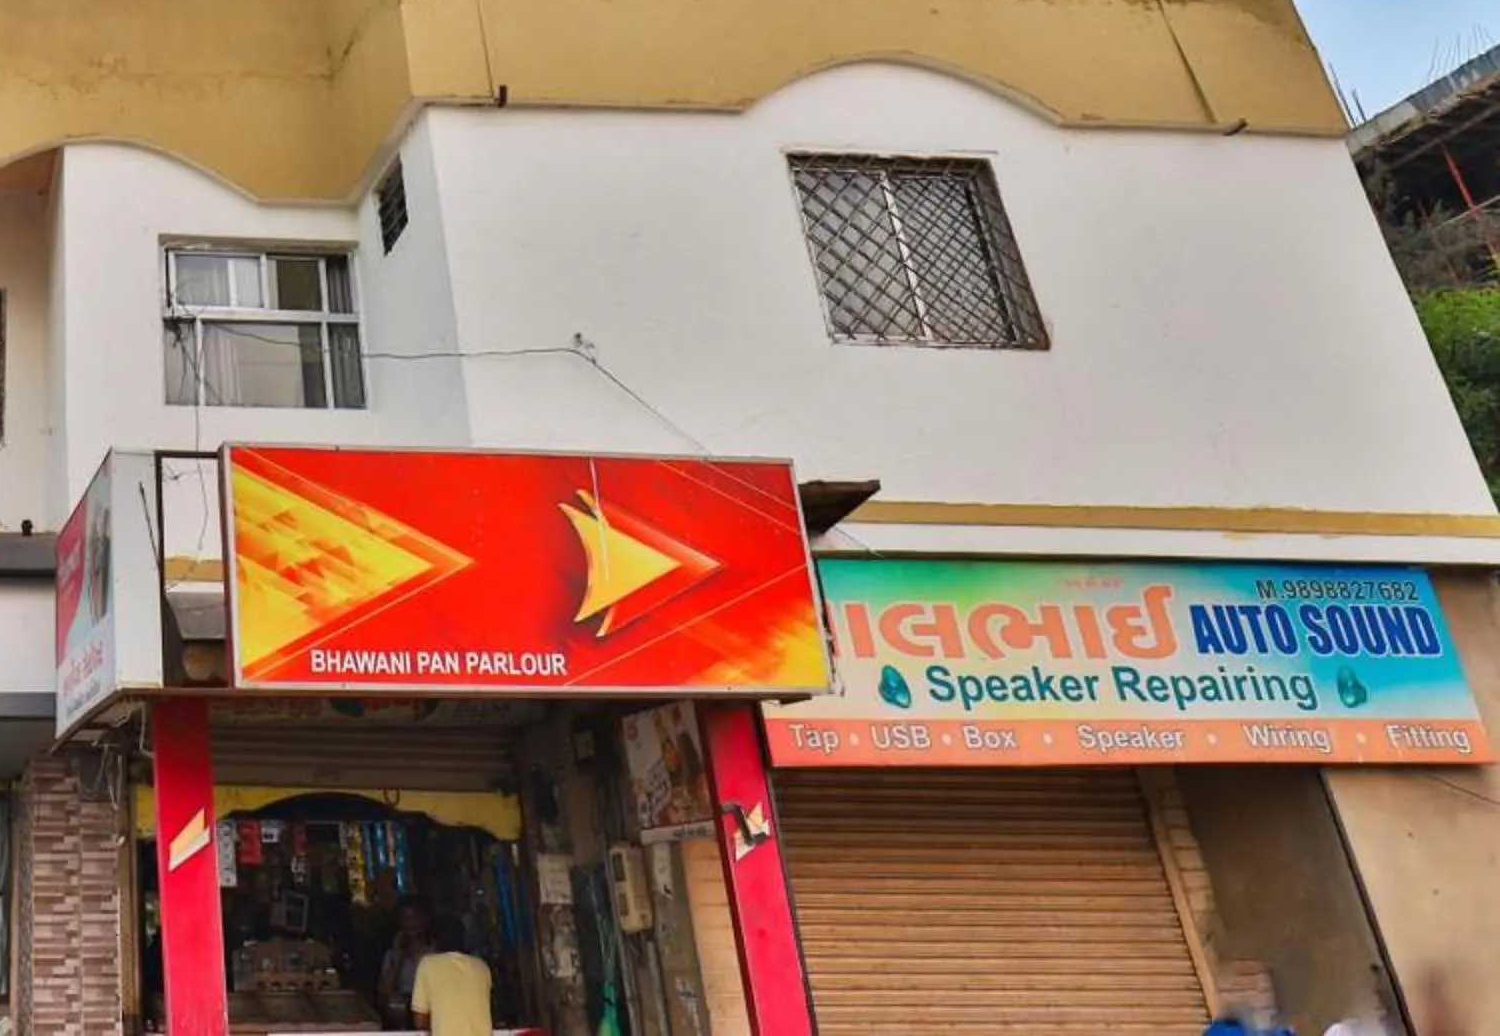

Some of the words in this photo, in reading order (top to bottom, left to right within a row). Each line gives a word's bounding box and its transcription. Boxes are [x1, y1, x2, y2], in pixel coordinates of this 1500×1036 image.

[1189, 604, 1299, 655] AUTO
[1300, 604, 1442, 655] SOUND
[311, 649, 411, 674] BHAWANI
[416, 651, 460, 675] PAN
[466, 652, 568, 676] PARLOUR
[928, 666, 1100, 711] Speaker
[1113, 665, 1318, 711] Repairing
[788, 724, 840, 752] Tap
[871, 726, 931, 750] USB
[963, 726, 1018, 750] Box
[1078, 726, 1187, 752] Speaker
[1243, 723, 1332, 753] Wiring
[1385, 724, 1473, 754] Fitting
